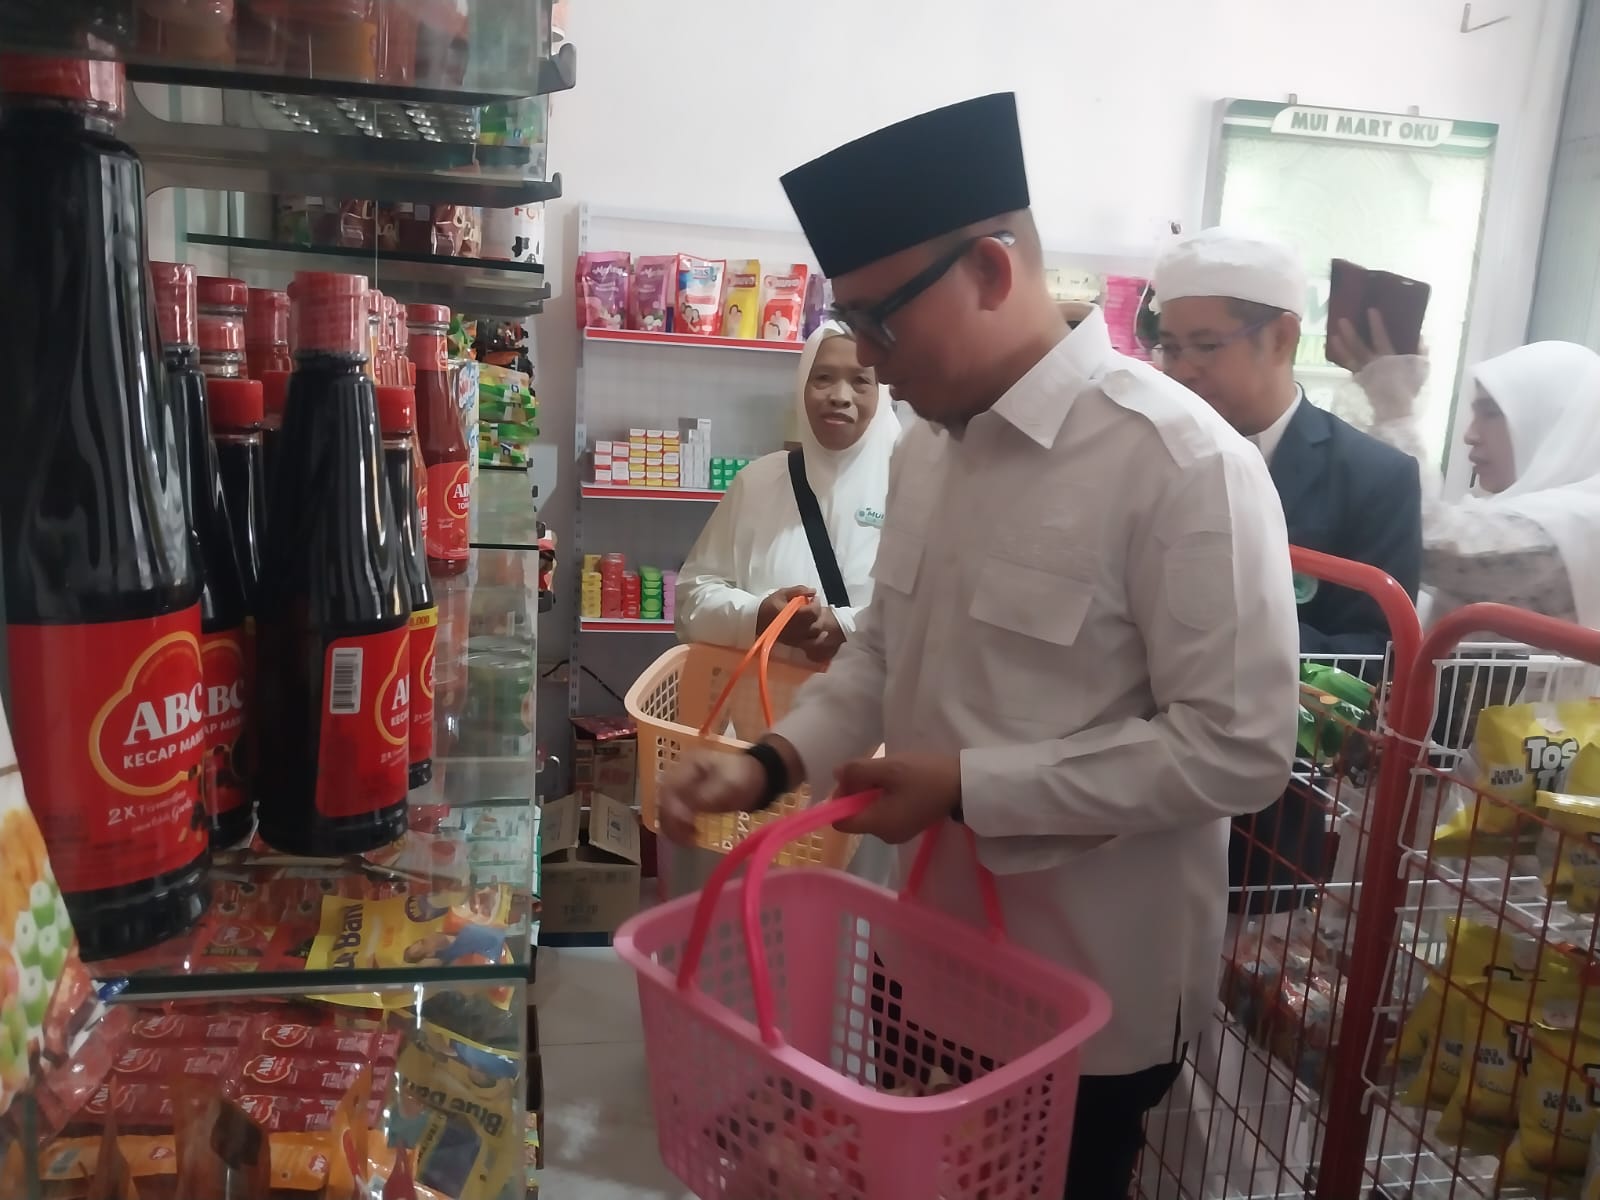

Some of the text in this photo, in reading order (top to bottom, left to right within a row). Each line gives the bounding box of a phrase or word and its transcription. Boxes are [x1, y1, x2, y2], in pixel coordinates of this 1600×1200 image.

[1290, 111, 1440, 142] MUI MART OKU
[122, 681, 203, 746] ABC
[204, 679, 245, 718] BC
[122, 744, 178, 769] KECAP
